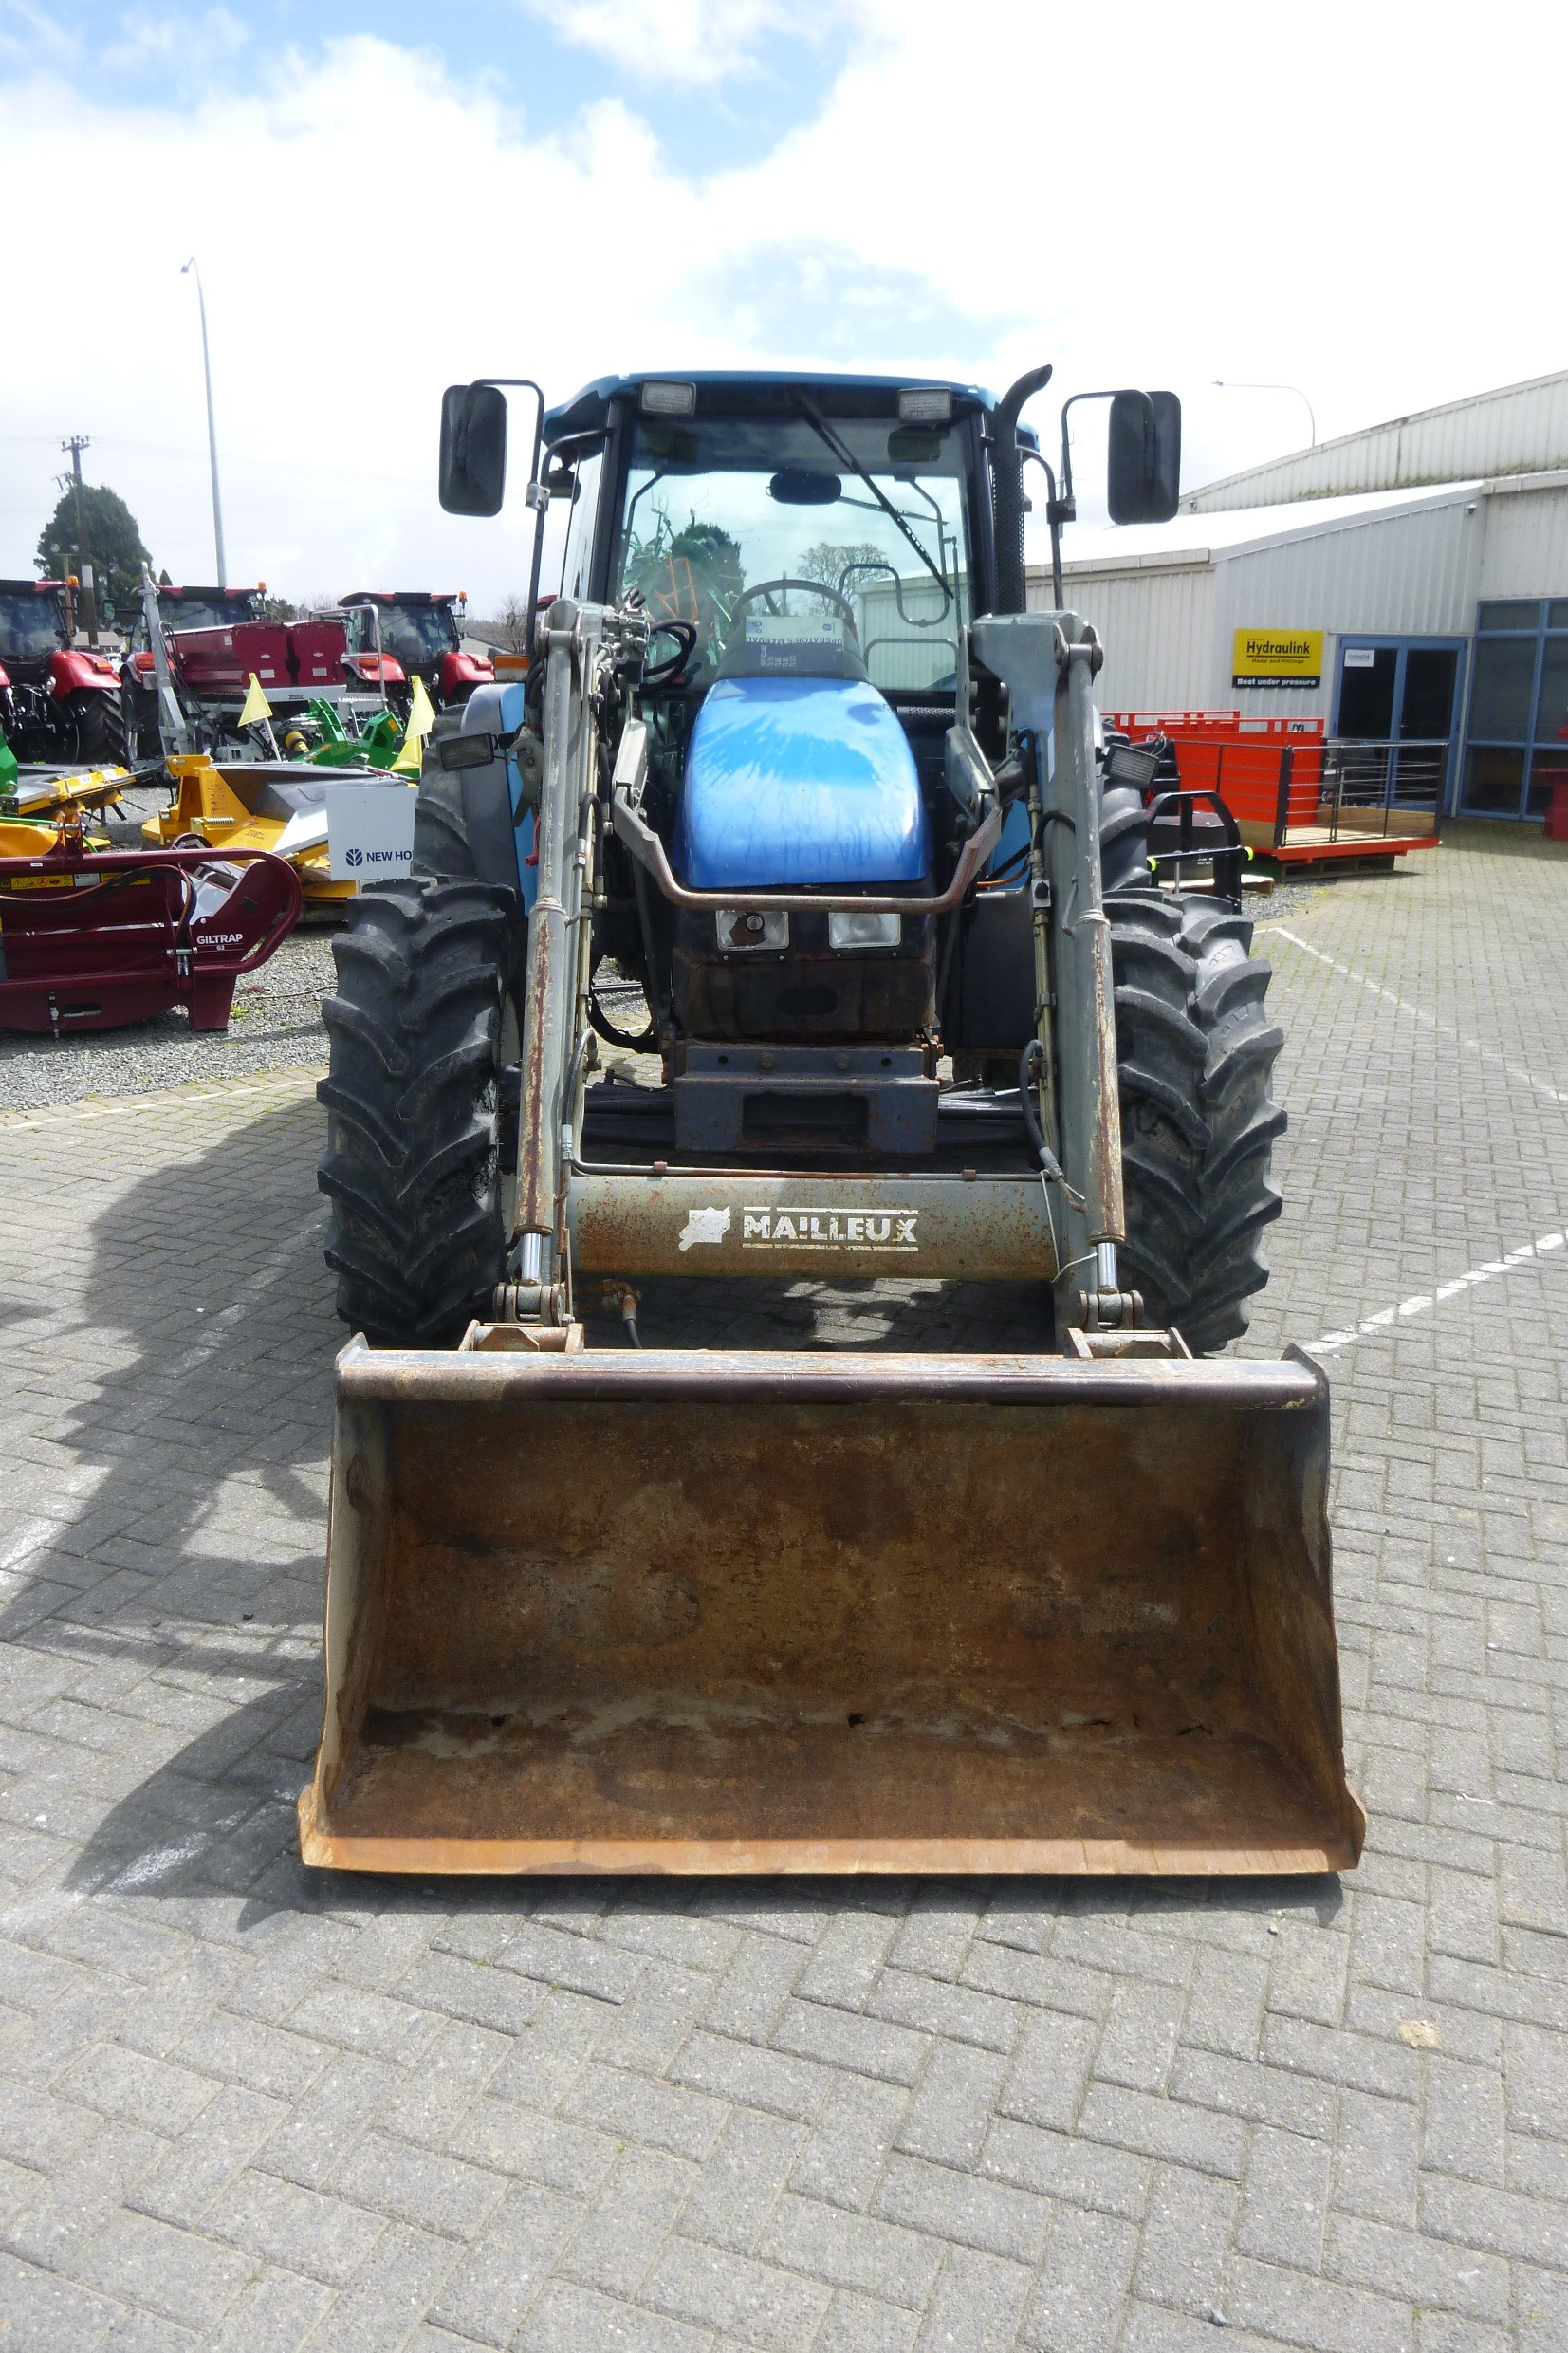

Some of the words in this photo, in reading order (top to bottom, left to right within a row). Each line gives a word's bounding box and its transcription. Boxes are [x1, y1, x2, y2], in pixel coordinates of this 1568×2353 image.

[1246, 640, 1310, 655] Hydraulink
[366, 851, 393, 862] NEW
[196, 933, 243, 945] GILTRAP
[743, 1215, 917, 1243] MAILLEUX
